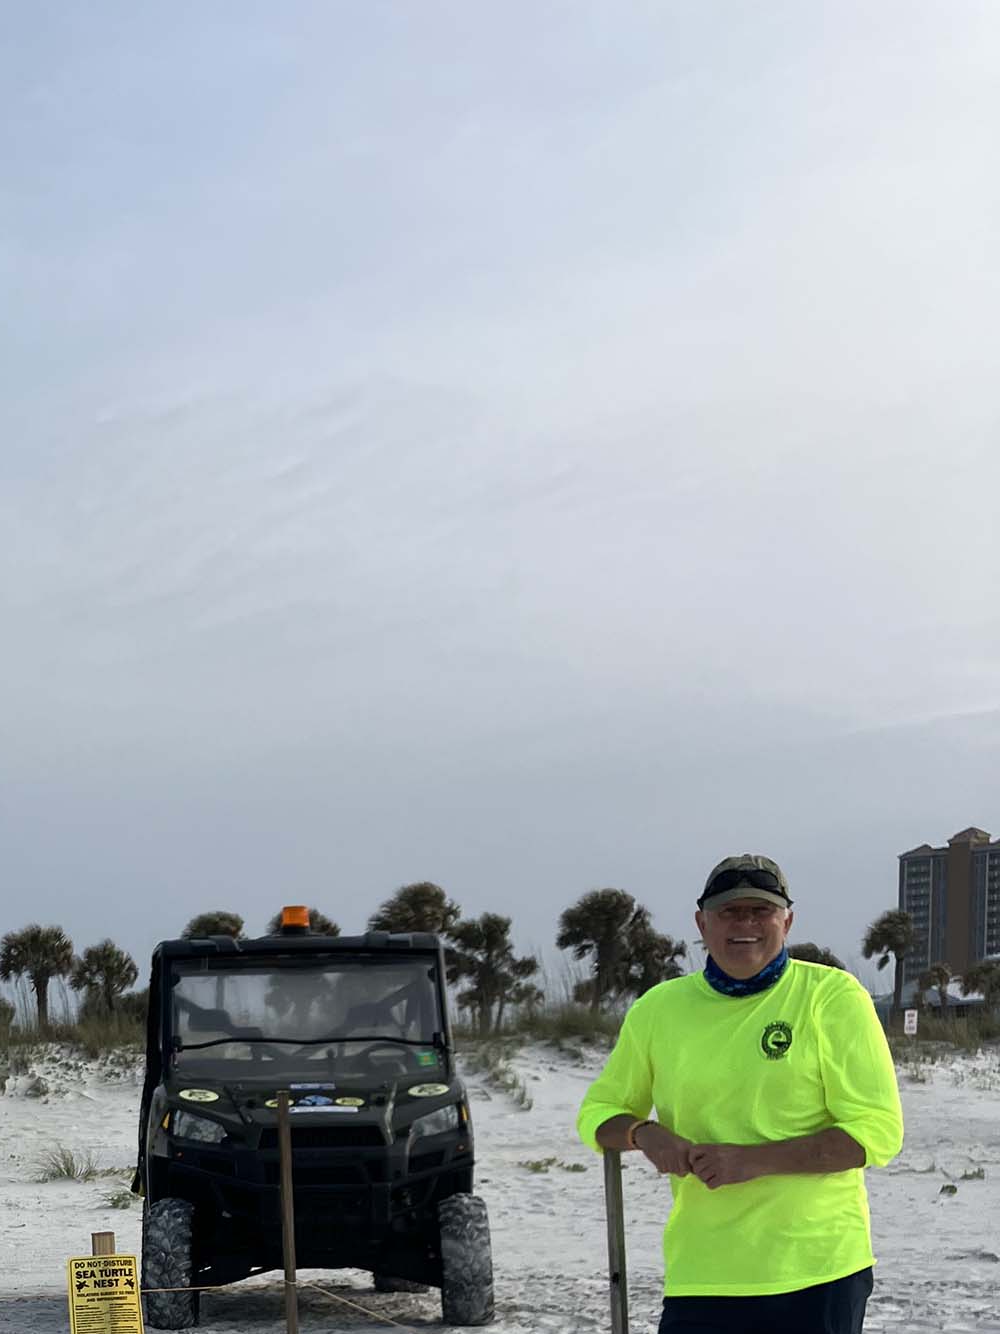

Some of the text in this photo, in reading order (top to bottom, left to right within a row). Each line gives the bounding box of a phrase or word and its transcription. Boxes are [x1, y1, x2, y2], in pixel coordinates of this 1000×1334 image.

[76, 1268, 133, 1279] SEA TURTLE
[94, 1278, 120, 1288] NEST
